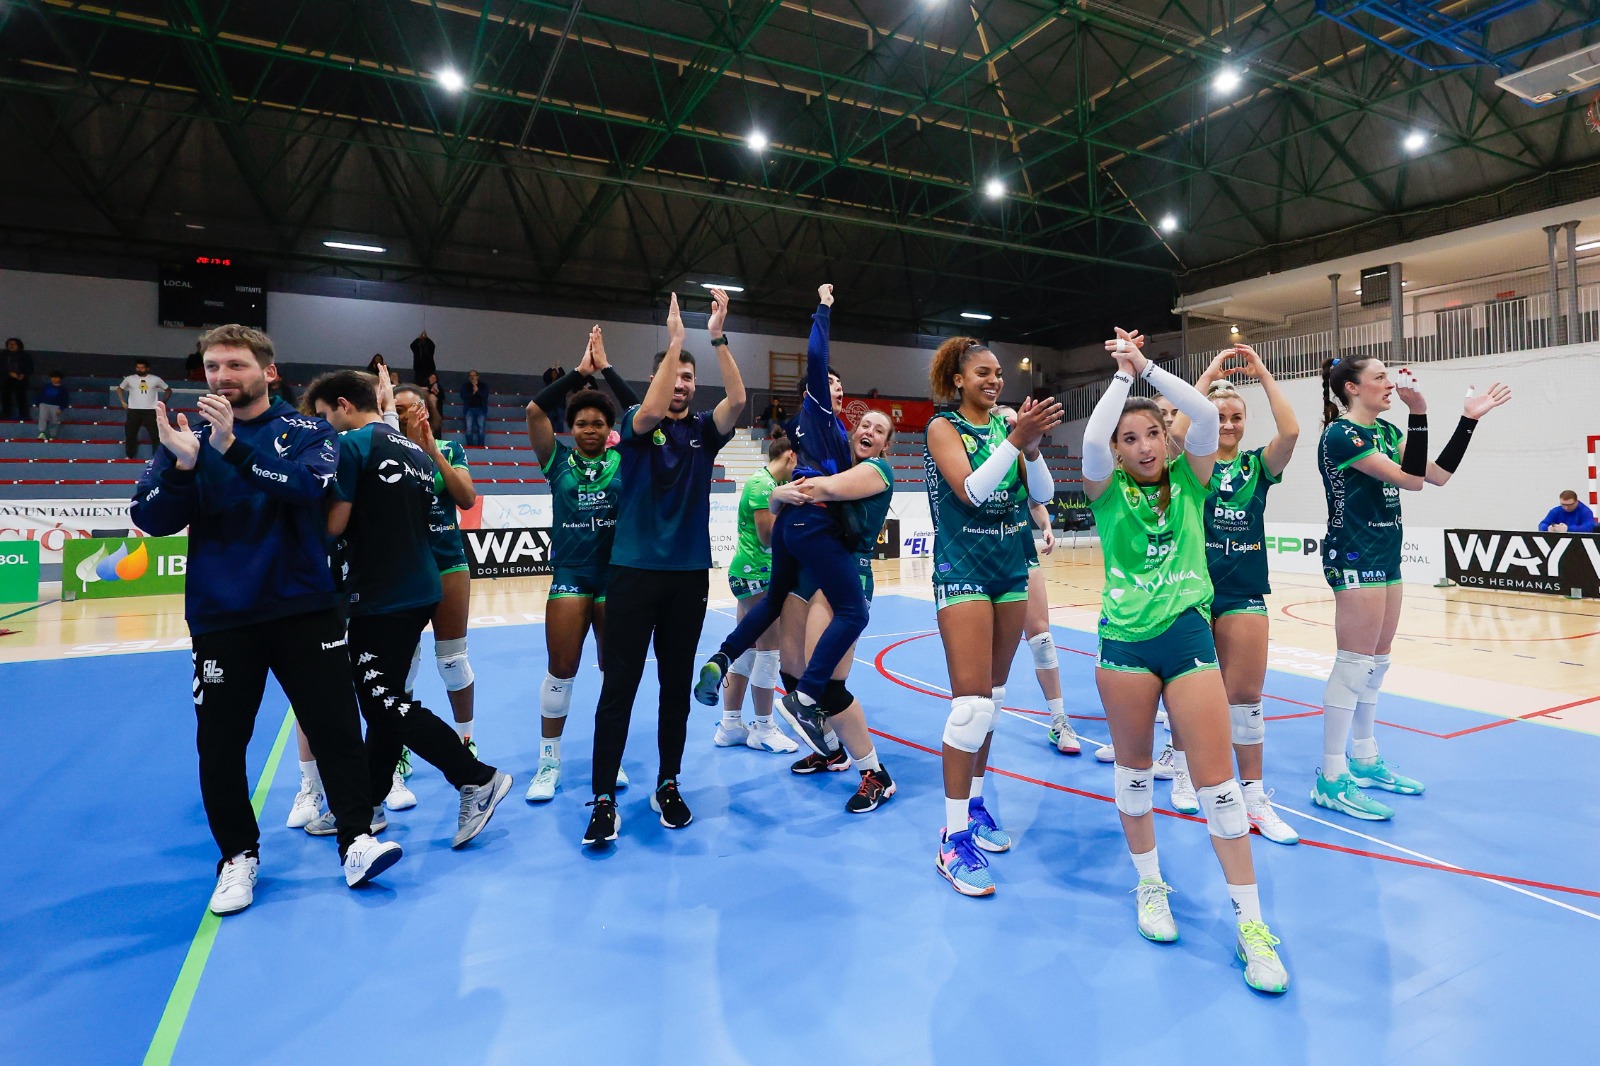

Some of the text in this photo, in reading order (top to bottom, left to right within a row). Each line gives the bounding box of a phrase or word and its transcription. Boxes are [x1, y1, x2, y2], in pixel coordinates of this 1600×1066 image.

[163, 280, 193, 288] LOCAL
[577, 491, 606, 502] PRO
[1214, 507, 1246, 520] PRO
[962, 526, 999, 535] Fundación
[1231, 541, 1261, 553] Cajasol
[1446, 532, 1573, 577] WAY
[477, 567, 499, 575] DOS
[947, 583, 984, 592] MAX
[1460, 575, 1561, 591] DOS HERMANAS
